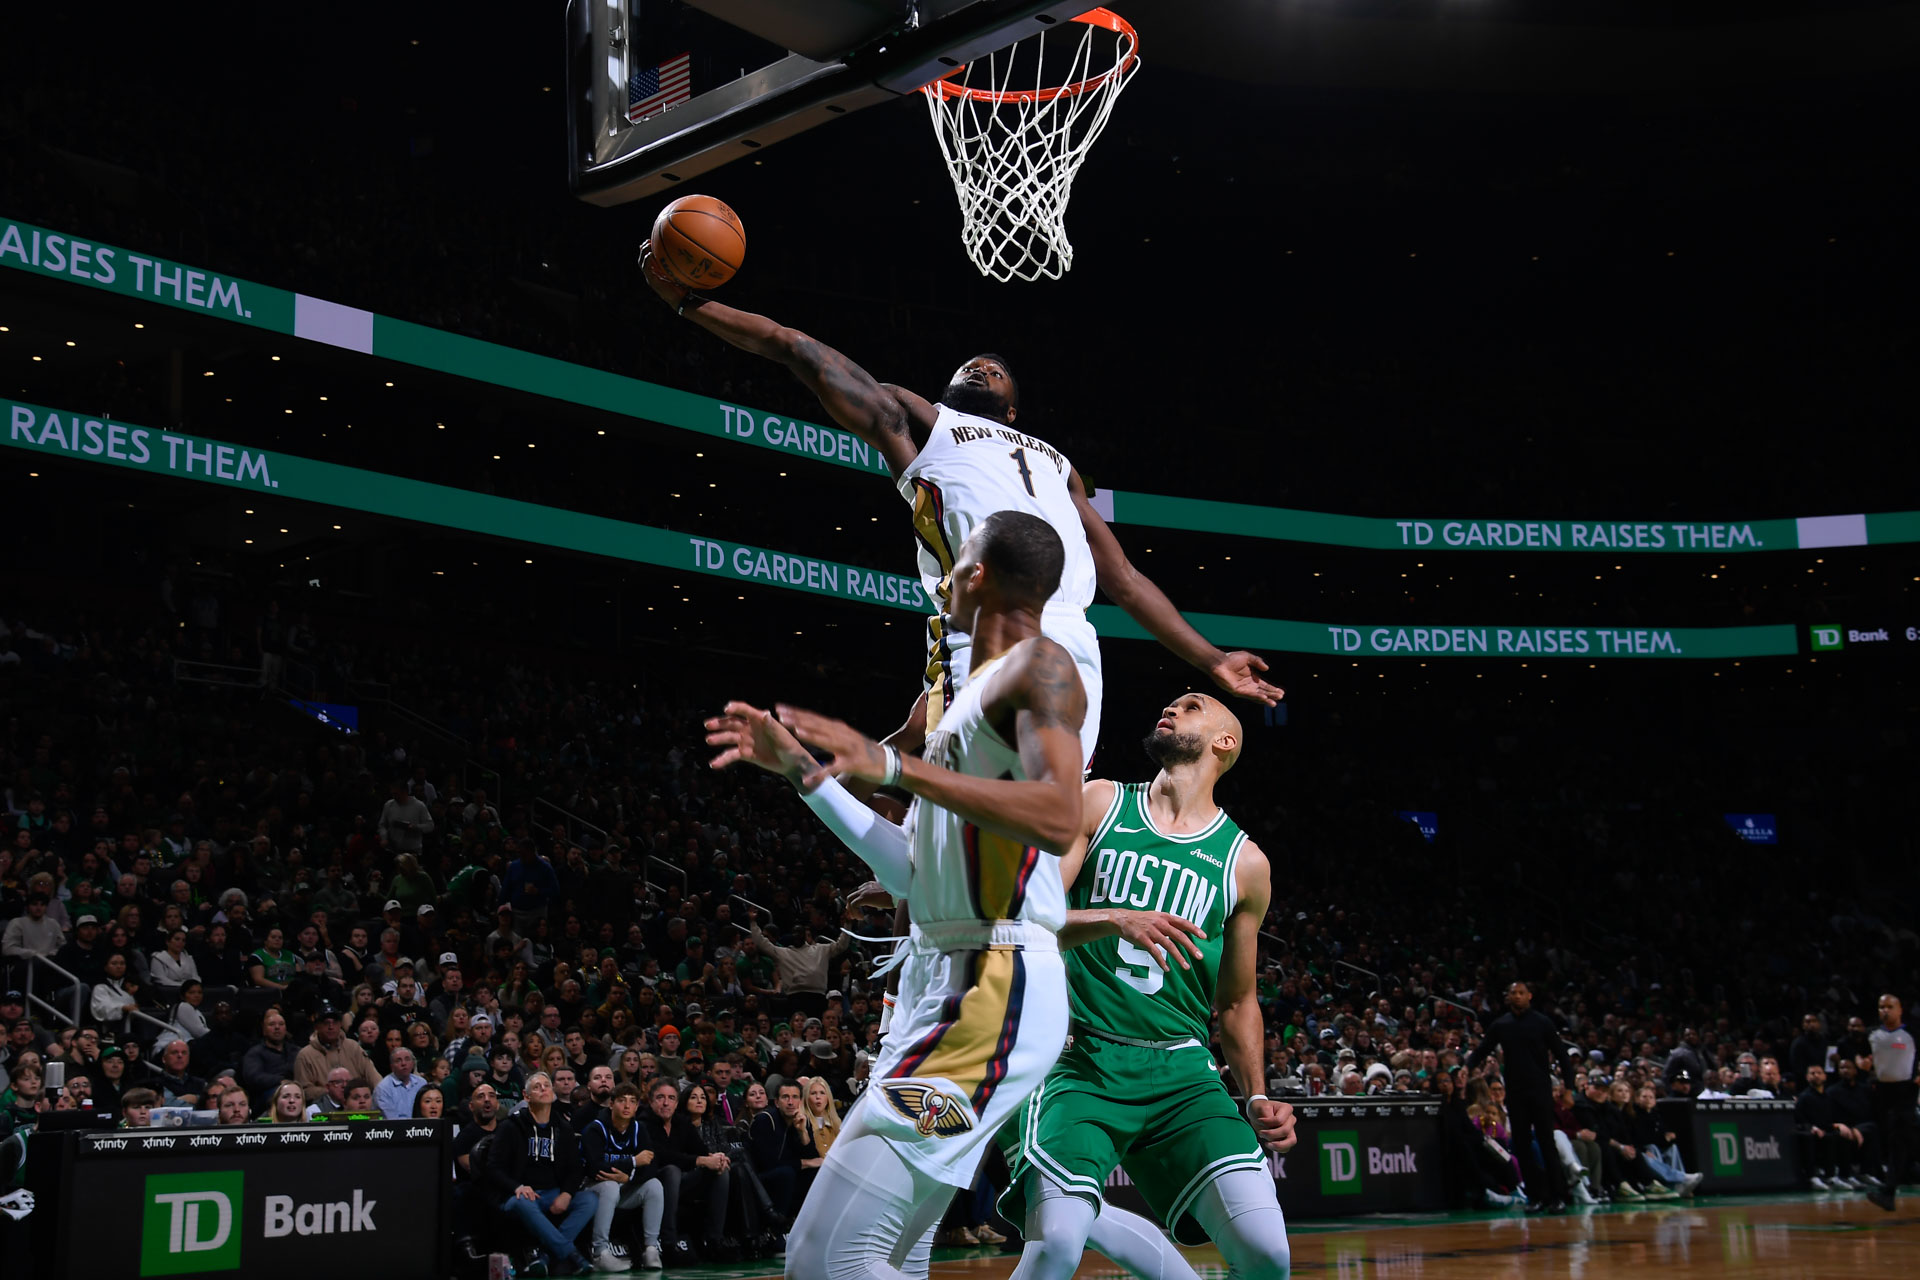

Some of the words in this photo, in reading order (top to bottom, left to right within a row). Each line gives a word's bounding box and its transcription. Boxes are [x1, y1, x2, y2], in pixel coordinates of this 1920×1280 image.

[129, 255, 251, 318] THEM.
[12, 406, 149, 463] RAISES
[162, 435, 278, 488] THEM.
[720, 404, 754, 437] TD
[764, 416, 869, 467] GARDEN
[950, 426, 992, 445] NEW
[1009, 447, 1036, 498] 1
[1397, 522, 1433, 545] TD
[1442, 522, 1562, 547] GARDEN
[1572, 524, 1665, 548] RAISES
[1673, 524, 1763, 548] THEM.
[690, 539, 724, 569] TD
[733, 547, 837, 591] GARDEN
[847, 567, 924, 607] RAISES
[1328, 627, 1361, 651] TD
[1370, 628, 1487, 652] GARDEN
[1498, 629, 1589, 653] RAISES
[1597, 630, 1682, 654] THEM.
[1813, 629, 1840, 646] TD
[1848, 628, 1889, 642] Bank
[1190, 848, 1223, 868] Amica
[1090, 848, 1218, 928] BOSTON
[93, 1139, 128, 1150] xfinity
[142, 1137, 176, 1148] xfinity
[189, 1135, 223, 1147] xfinity
[235, 1133, 267, 1145] xfinity
[280, 1131, 311, 1143] xfinity
[323, 1130, 353, 1142] xfinity
[365, 1128, 394, 1140] xfinity
[405, 1126, 434, 1138] xfinity
[1712, 1132, 1739, 1166] TD
[1744, 1136, 1781, 1160] Bank
[1322, 1142, 1357, 1182] TD
[1367, 1144, 1418, 1175] Bank
[155, 1191, 232, 1253] TD
[264, 1189, 377, 1238] Bank
